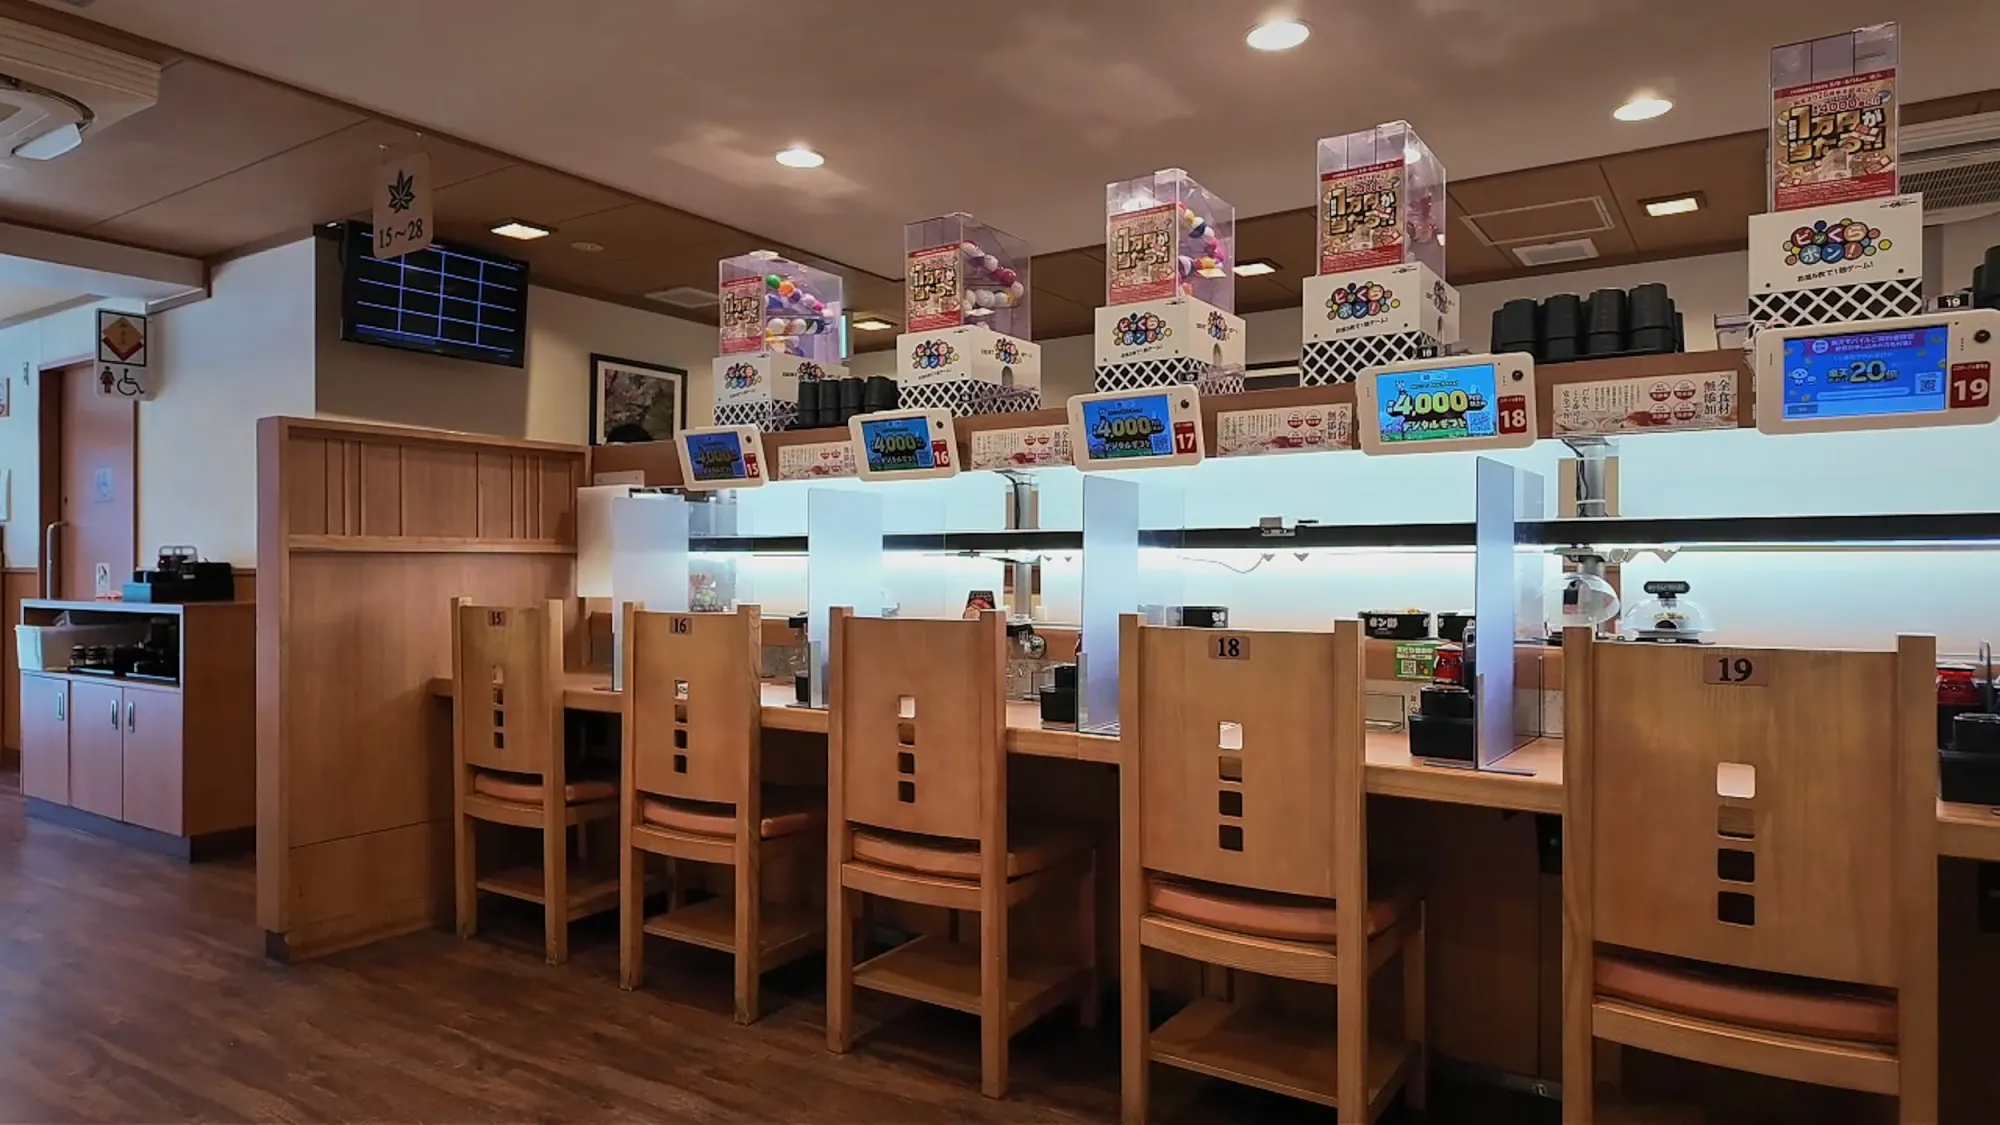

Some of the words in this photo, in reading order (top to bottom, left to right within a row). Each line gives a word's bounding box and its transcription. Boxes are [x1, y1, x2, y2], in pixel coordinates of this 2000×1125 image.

[1790, 104, 1884, 139] 1万円が
[1332, 187, 1396, 215] 1万円が
[1793, 223, 1867, 246] ビッくら
[1946, 297, 1961, 307] 19
[1954, 378, 1988, 401] 19
[1393, 389, 1468, 416] 4,000
[1500, 409, 1526, 429] 18
[1176, 433, 1195, 450] 17
[933, 451, 949, 465] 16
[746, 462, 759, 476] 15
[491, 612, 502, 625] 15
[674, 618, 687, 633] 16
[1218, 637, 1240, 657] 18
[1718, 657, 1753, 682] 19
